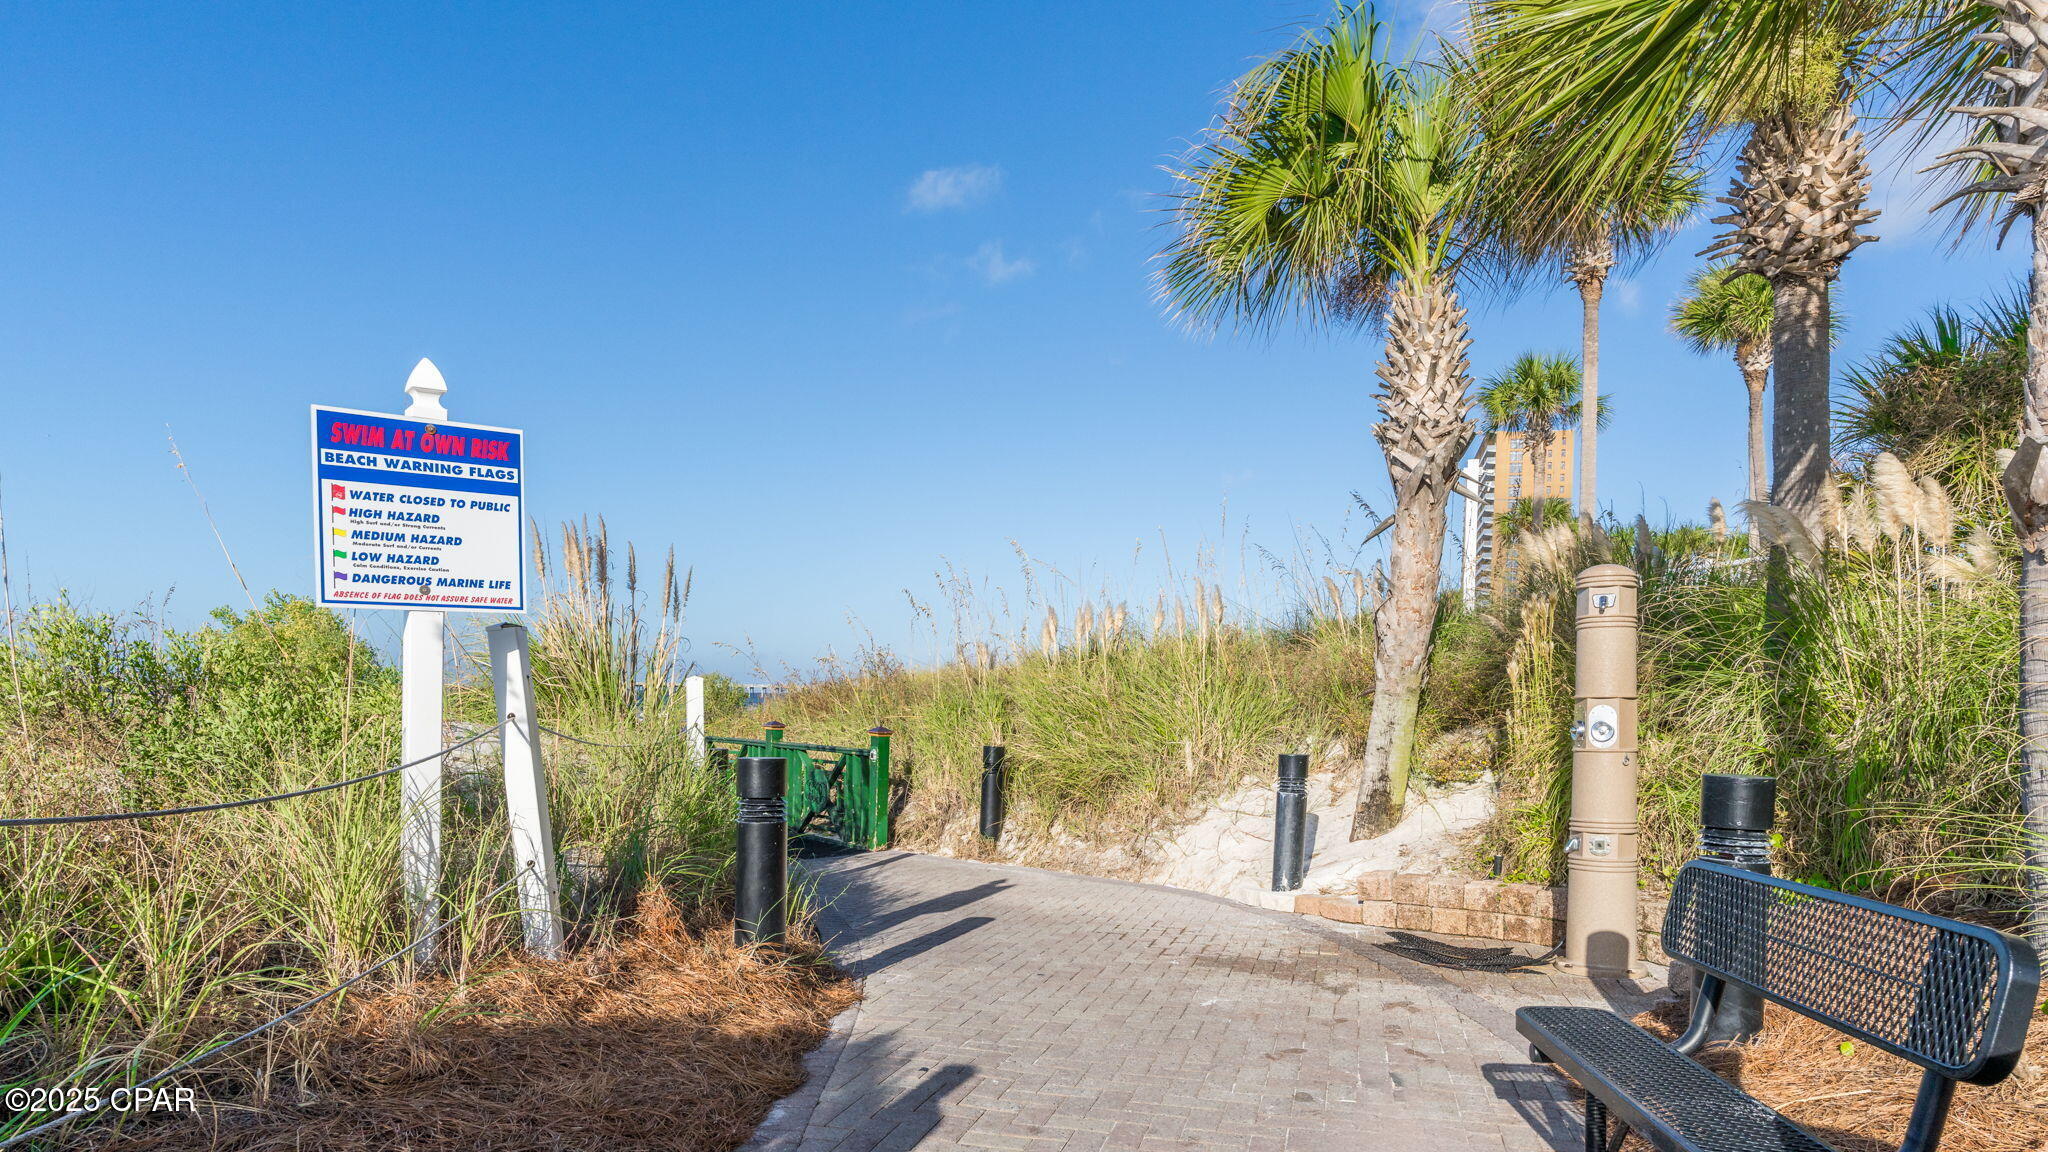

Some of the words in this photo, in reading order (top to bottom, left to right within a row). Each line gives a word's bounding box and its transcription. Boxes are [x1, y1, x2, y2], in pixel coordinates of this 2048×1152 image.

[330, 422, 385, 448] SWIM
[391, 429, 415, 451] AT
[420, 433, 465, 457] OWN
[470, 438, 511, 461] RISK
[325, 452, 377, 467] BEACH
[384, 458, 463, 475] WARNING
[470, 467, 515, 480] FLAGS
[350, 490, 395, 503] WATER
[399, 495, 445, 507] CLOSED
[450, 499, 466, 508] TO
[470, 501, 511, 512] PUBLIC
[349, 508, 382, 519] HIGH
[387, 511, 440, 523] HAZARD
[351, 530, 406, 543] MEDIUM
[410, 534, 462, 545] HAZARD
[351, 552, 382, 562] LOW
[386, 554, 439, 565] HAZARD
[352, 574, 432, 586] DANGEROUS
[437, 578, 484, 588] MARINE
[489, 581, 511, 590] LIFE
